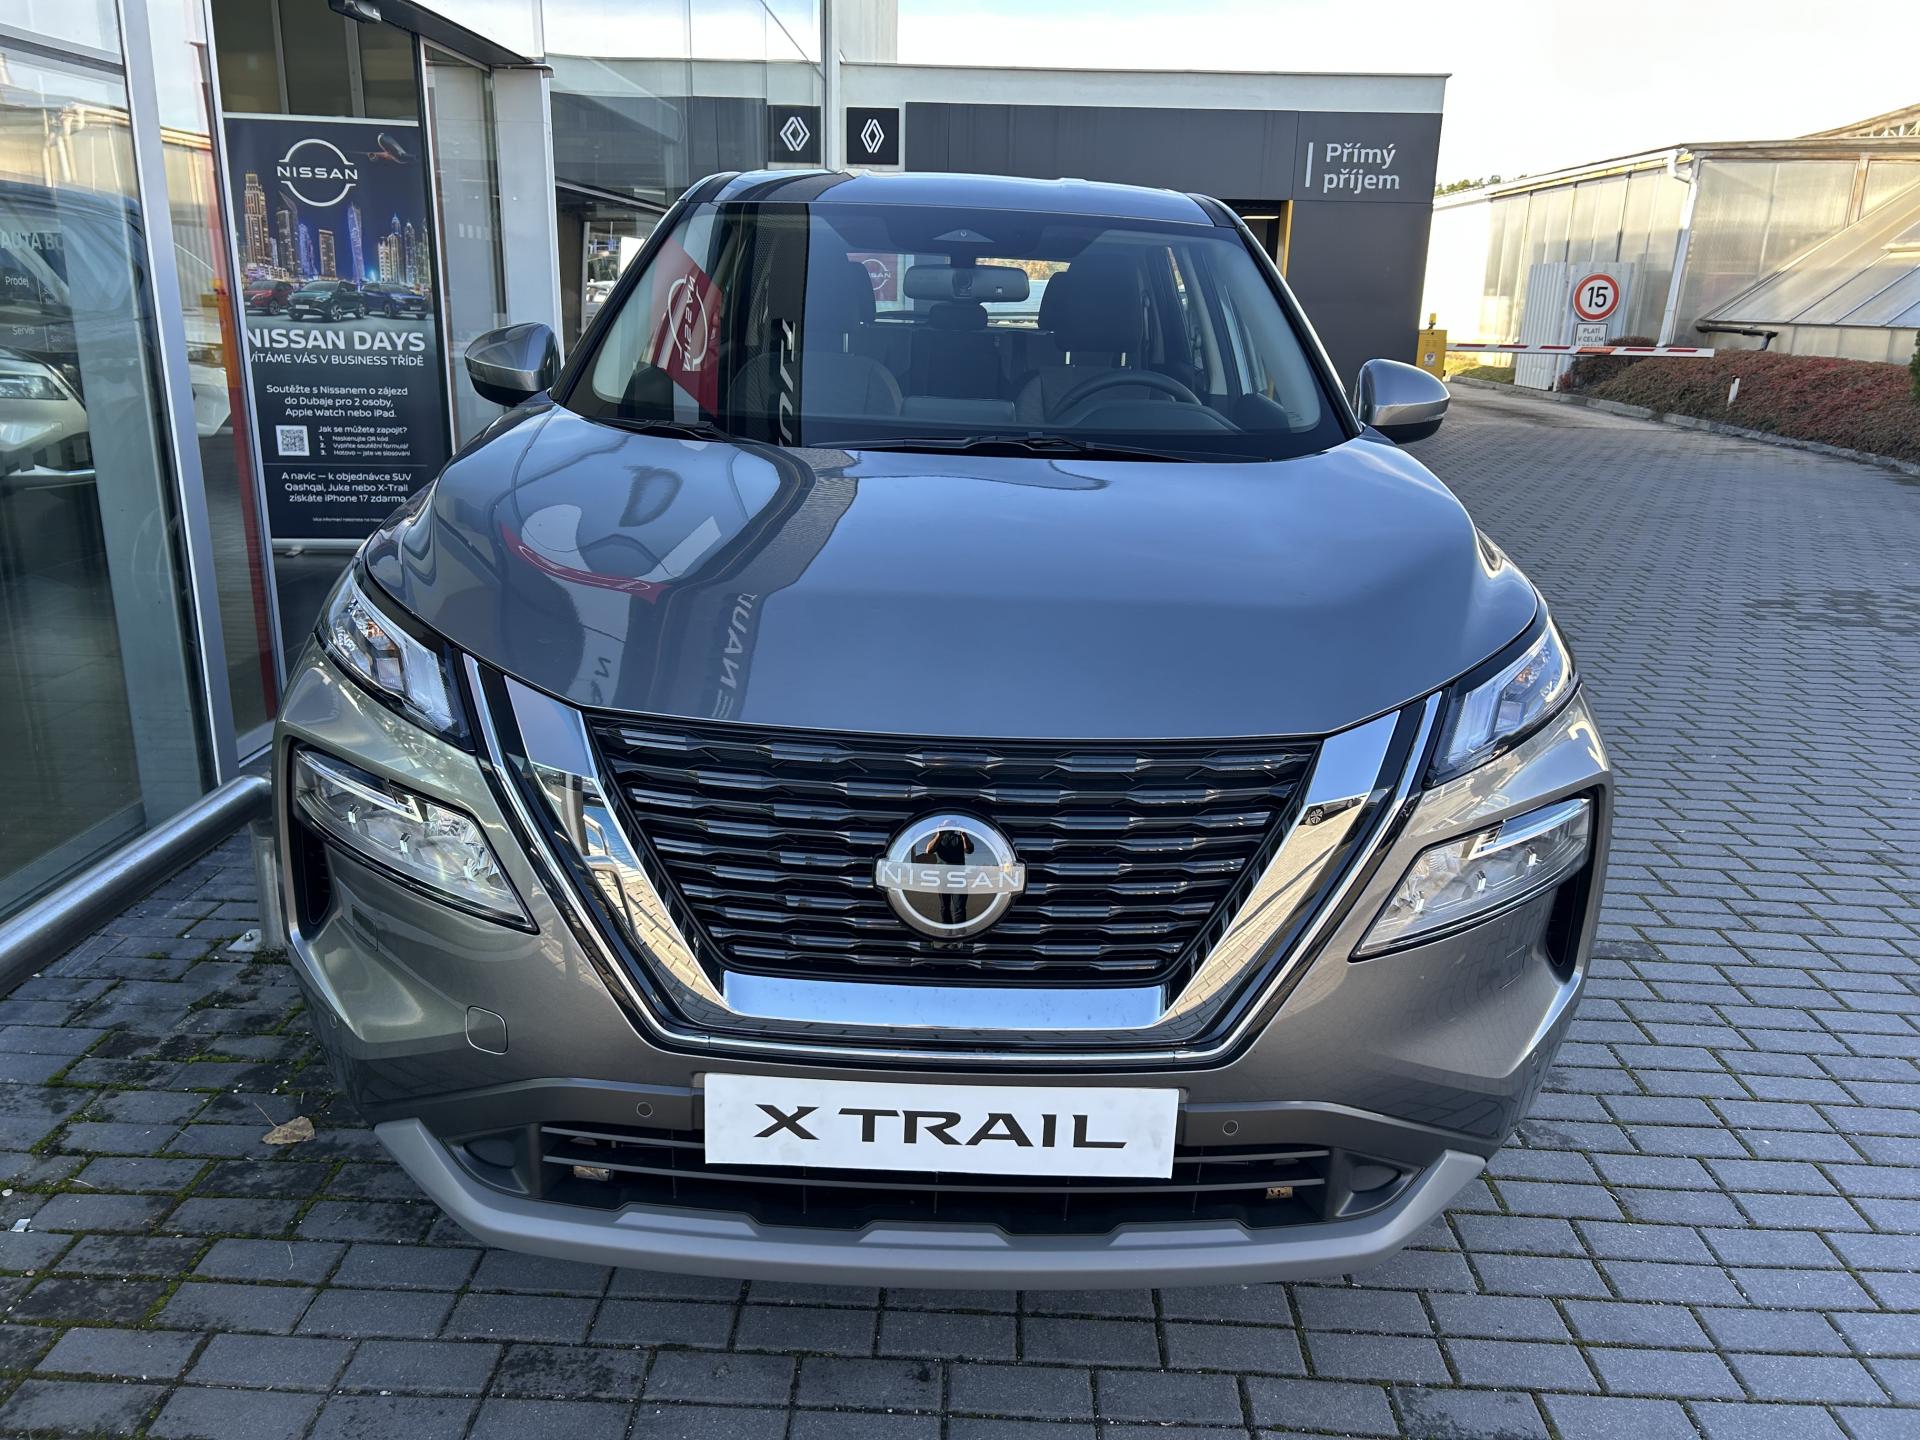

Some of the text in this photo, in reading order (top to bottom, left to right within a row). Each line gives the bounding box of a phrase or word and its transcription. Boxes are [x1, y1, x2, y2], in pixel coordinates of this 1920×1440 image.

[1326, 143, 1396, 169] Přímý
[276, 166, 358, 180] NISSAN
[1323, 168, 1400, 194] příjem
[5, 276, 30, 288] Prodej
[1588, 286, 1608, 308] 15
[12, 326, 36, 337] Servis
[247, 328, 426, 352] NISSAN DAYS
[294, 352, 318, 364] VÁS
[319, 355, 329, 364] V
[332, 355, 388, 366] BUSINESS
[390, 353, 424, 367] TŘÍDĚ
[266, 384, 310, 394] Soutěžte
[320, 385, 367, 395] Nissanem
[377, 386, 408, 397] zájezd
[284, 397, 394, 408] do Dubaje pro 2 osoby,
[285, 408, 397, 418] Apple Watch nebo iPad.
[318, 425, 332, 433] Jak
[344, 425, 375, 433] můžete
[376, 426, 408, 436] zapojit?
[281, 472, 290, 480] A
[290, 471, 316, 480] navíc
[328, 472, 335, 480] k
[335, 472, 390, 483] objednávce
[392, 472, 412, 481] SUV
[284, 483, 408, 493] Qashqai, Juke nebo X-Trail
[289, 494, 323, 503] získáte
[324, 494, 357, 502] iPhone
[359, 494, 368, 502] 17
[880, 862, 1021, 889] NISSAN
[753, 1103, 1127, 1150] X TRAIL
